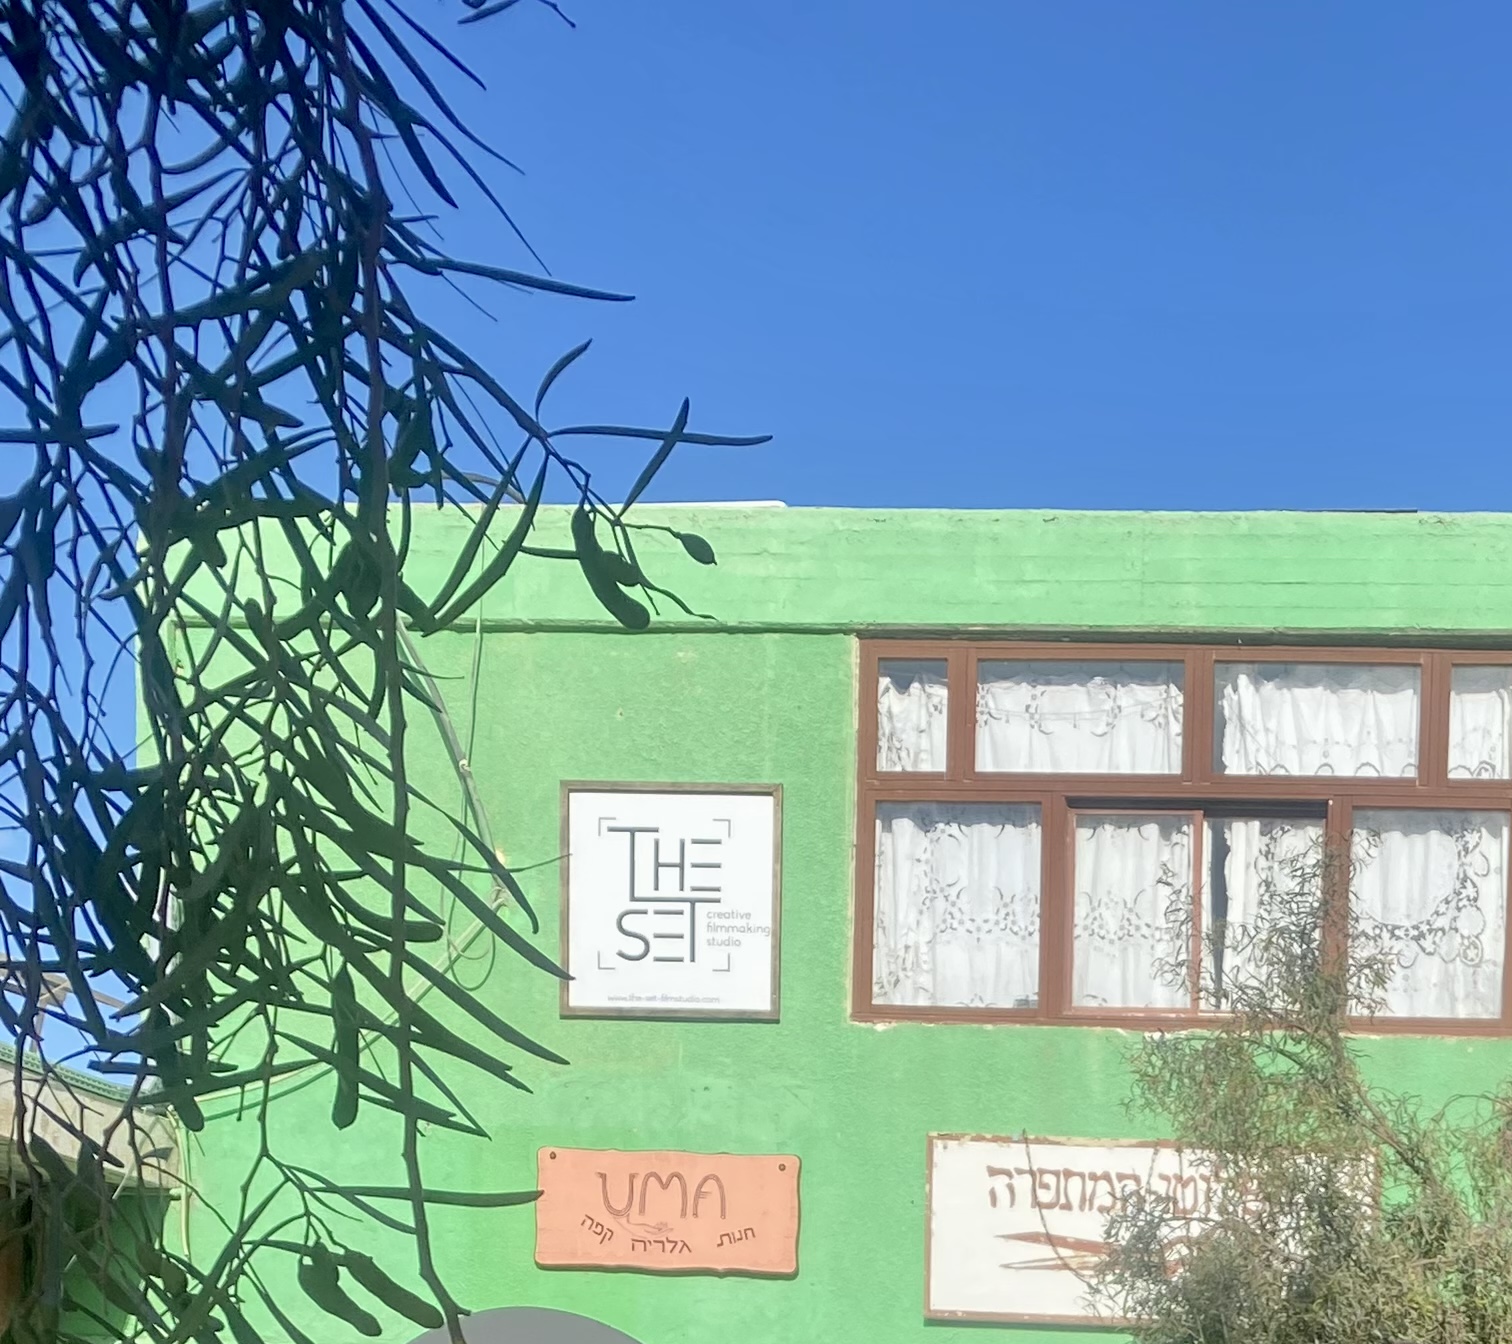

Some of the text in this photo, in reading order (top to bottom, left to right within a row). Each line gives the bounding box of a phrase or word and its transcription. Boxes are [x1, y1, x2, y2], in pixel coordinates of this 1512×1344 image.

[607, 826, 722, 901] THE
[616, 897, 722, 963] SET
[706, 909, 752, 920] creative
[706, 922, 771, 937] filmmaking
[706, 936, 742, 947] studio
[595, 1171, 726, 1219] UMA
[986, 1165, 1143, 1214] המתפרה
[580, 1214, 614, 1245] קפה
[716, 1227, 756, 1248] חנות
